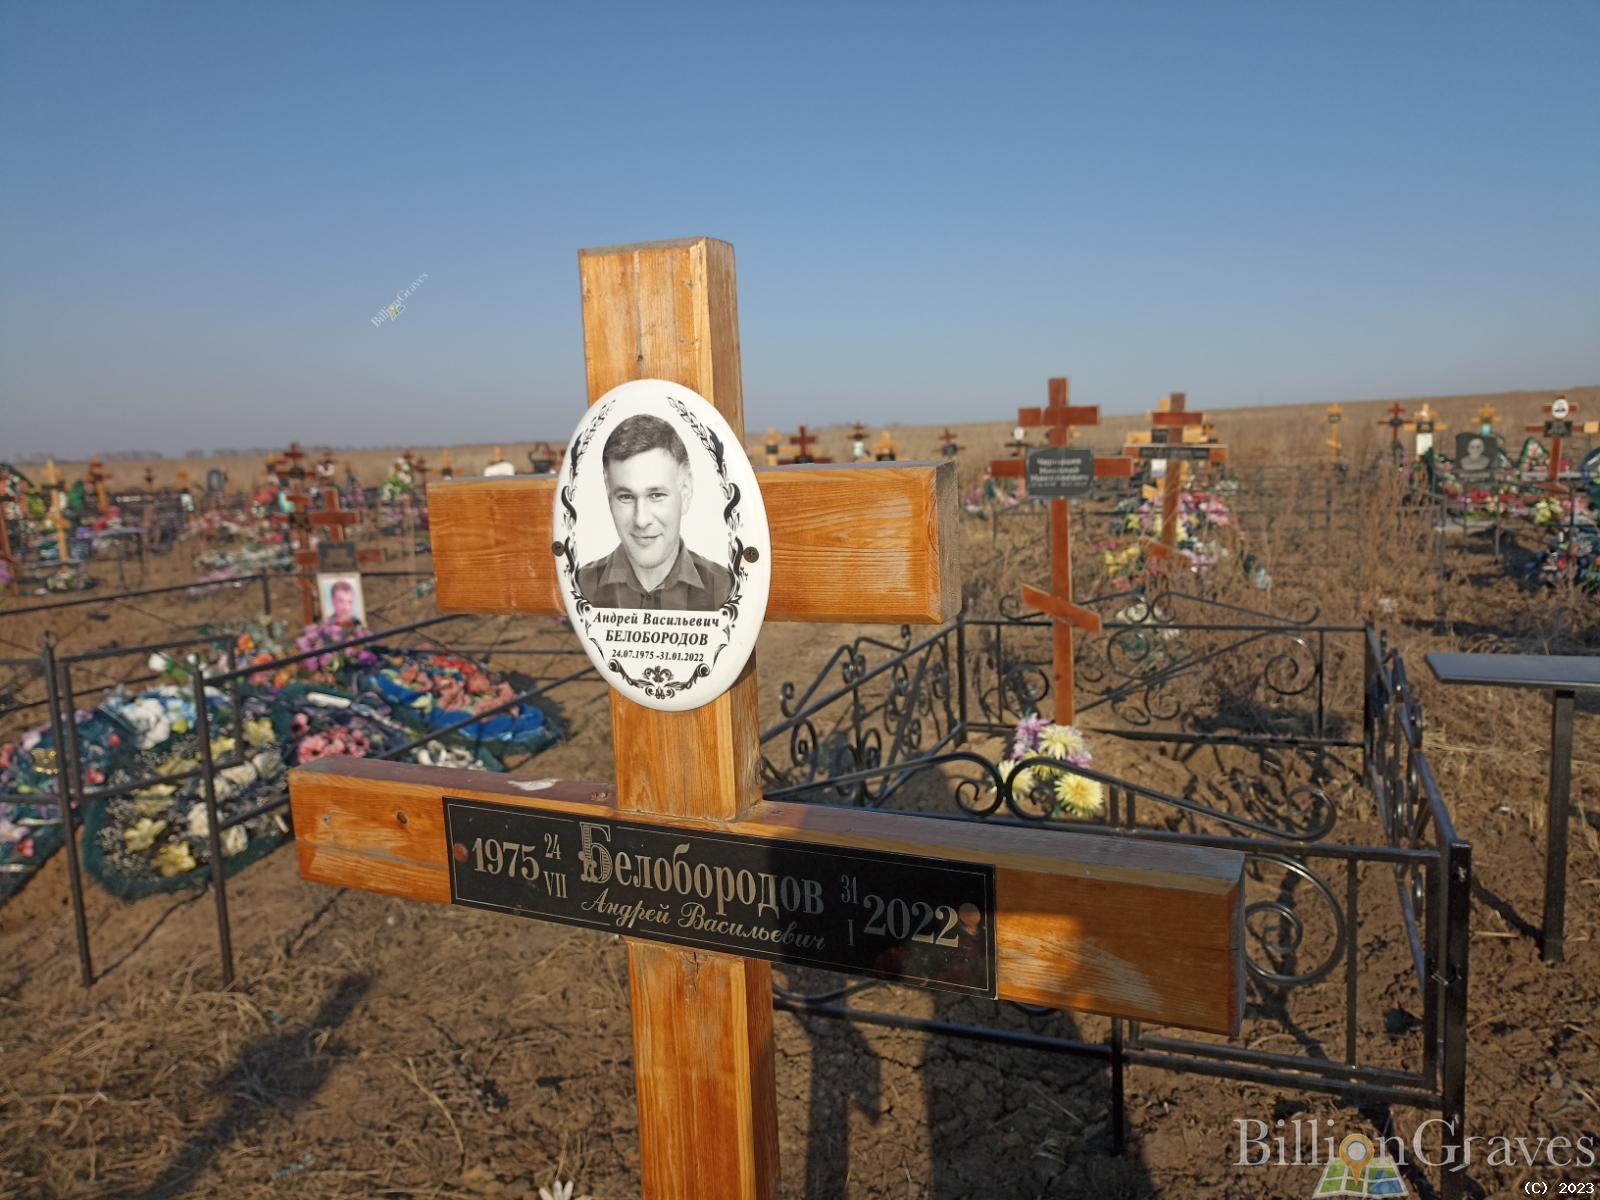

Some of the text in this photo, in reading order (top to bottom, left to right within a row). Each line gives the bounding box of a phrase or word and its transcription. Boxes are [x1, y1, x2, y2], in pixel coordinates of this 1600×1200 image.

[593, 611, 719, 627] Андрей Васильевич
[606, 630, 709, 647] БЕЛОБОРОДОВ
[612, 649, 654, 660] 24.07.1975
[471, 837, 541, 881] 1975
[543, 833, 561, 860] 24
[577, 821, 825, 917] Белобородов
[543, 871, 569, 899] VII
[840, 874, 859, 905] 31
[580, 887, 827, 951] Андрей Васильевич
[863, 894, 960, 949] 2022
